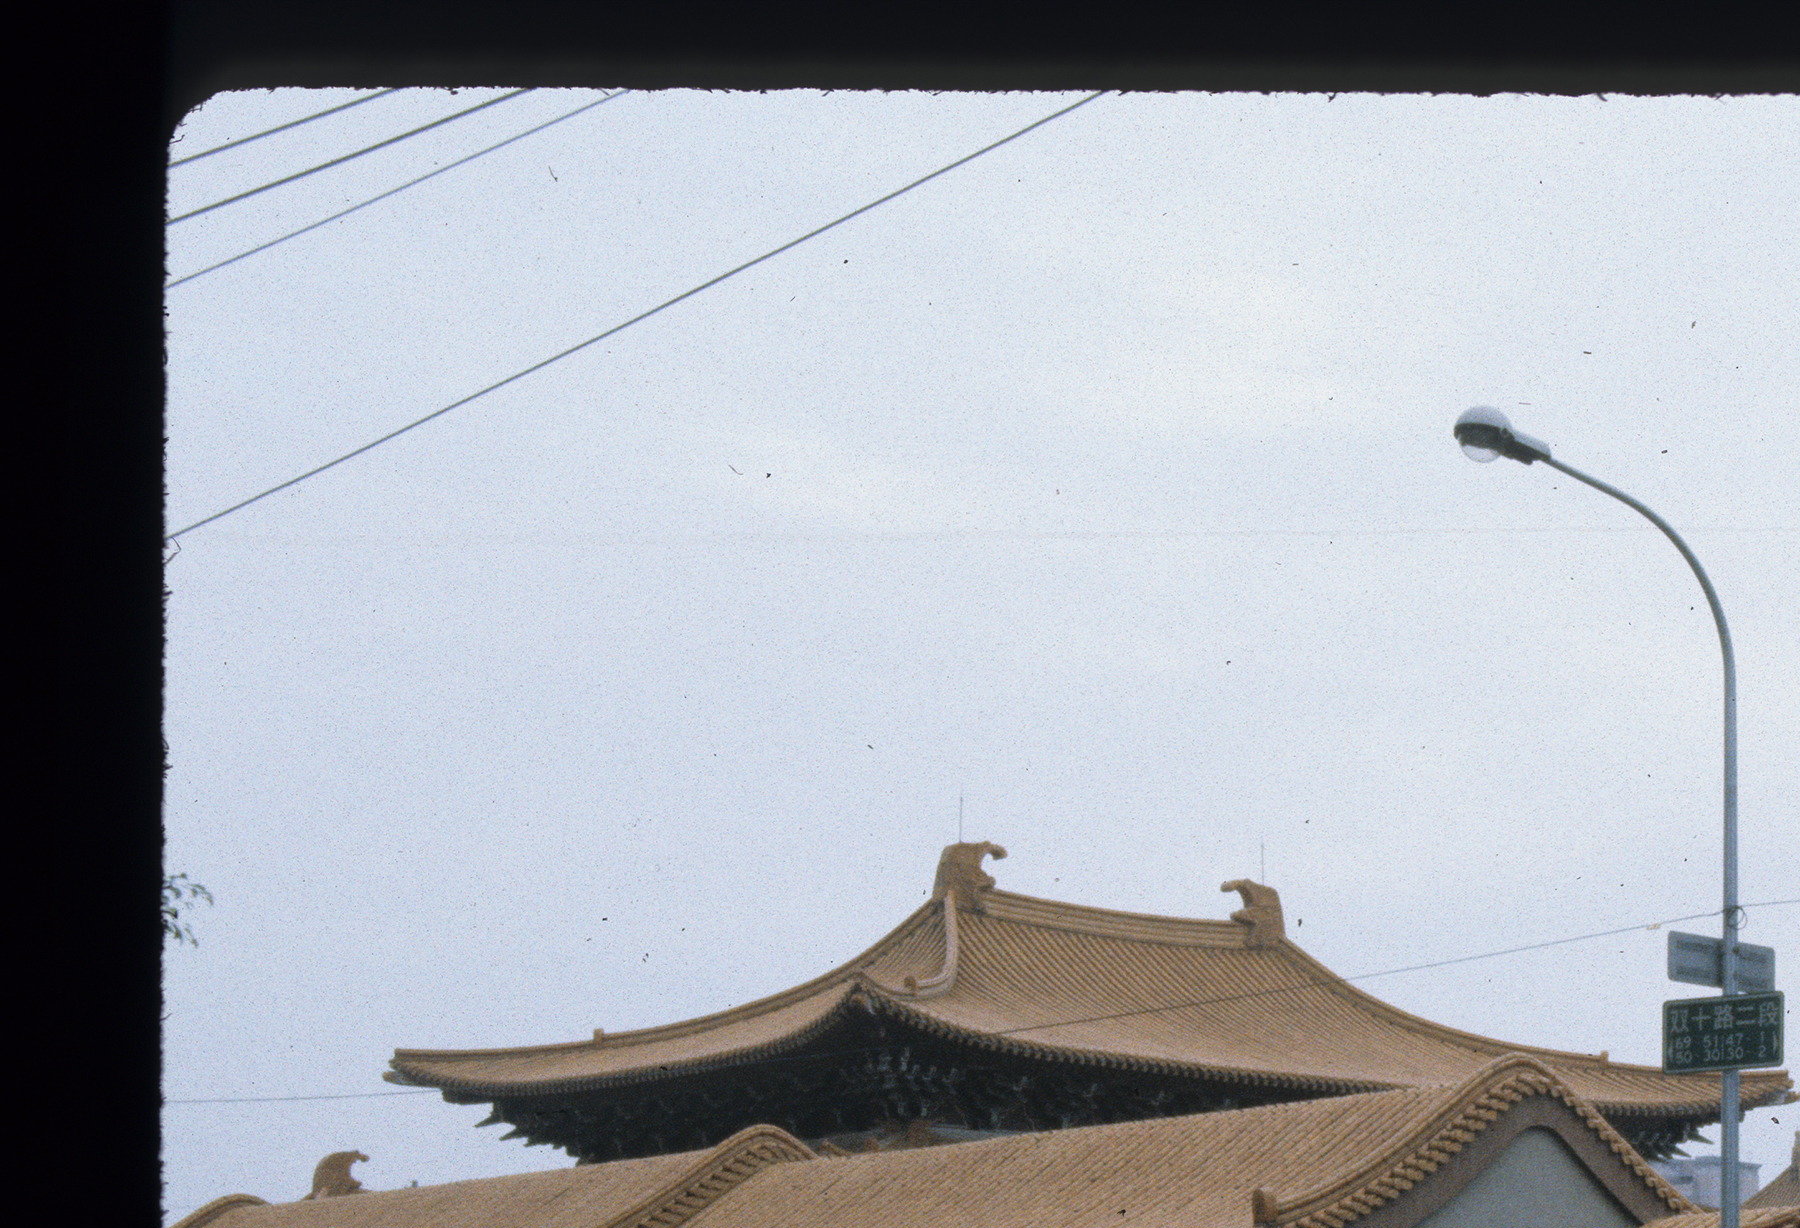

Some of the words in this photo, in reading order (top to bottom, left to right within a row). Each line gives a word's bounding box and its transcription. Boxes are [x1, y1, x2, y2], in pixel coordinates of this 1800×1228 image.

[1670, 1002, 1779, 1033] 双十路二段
